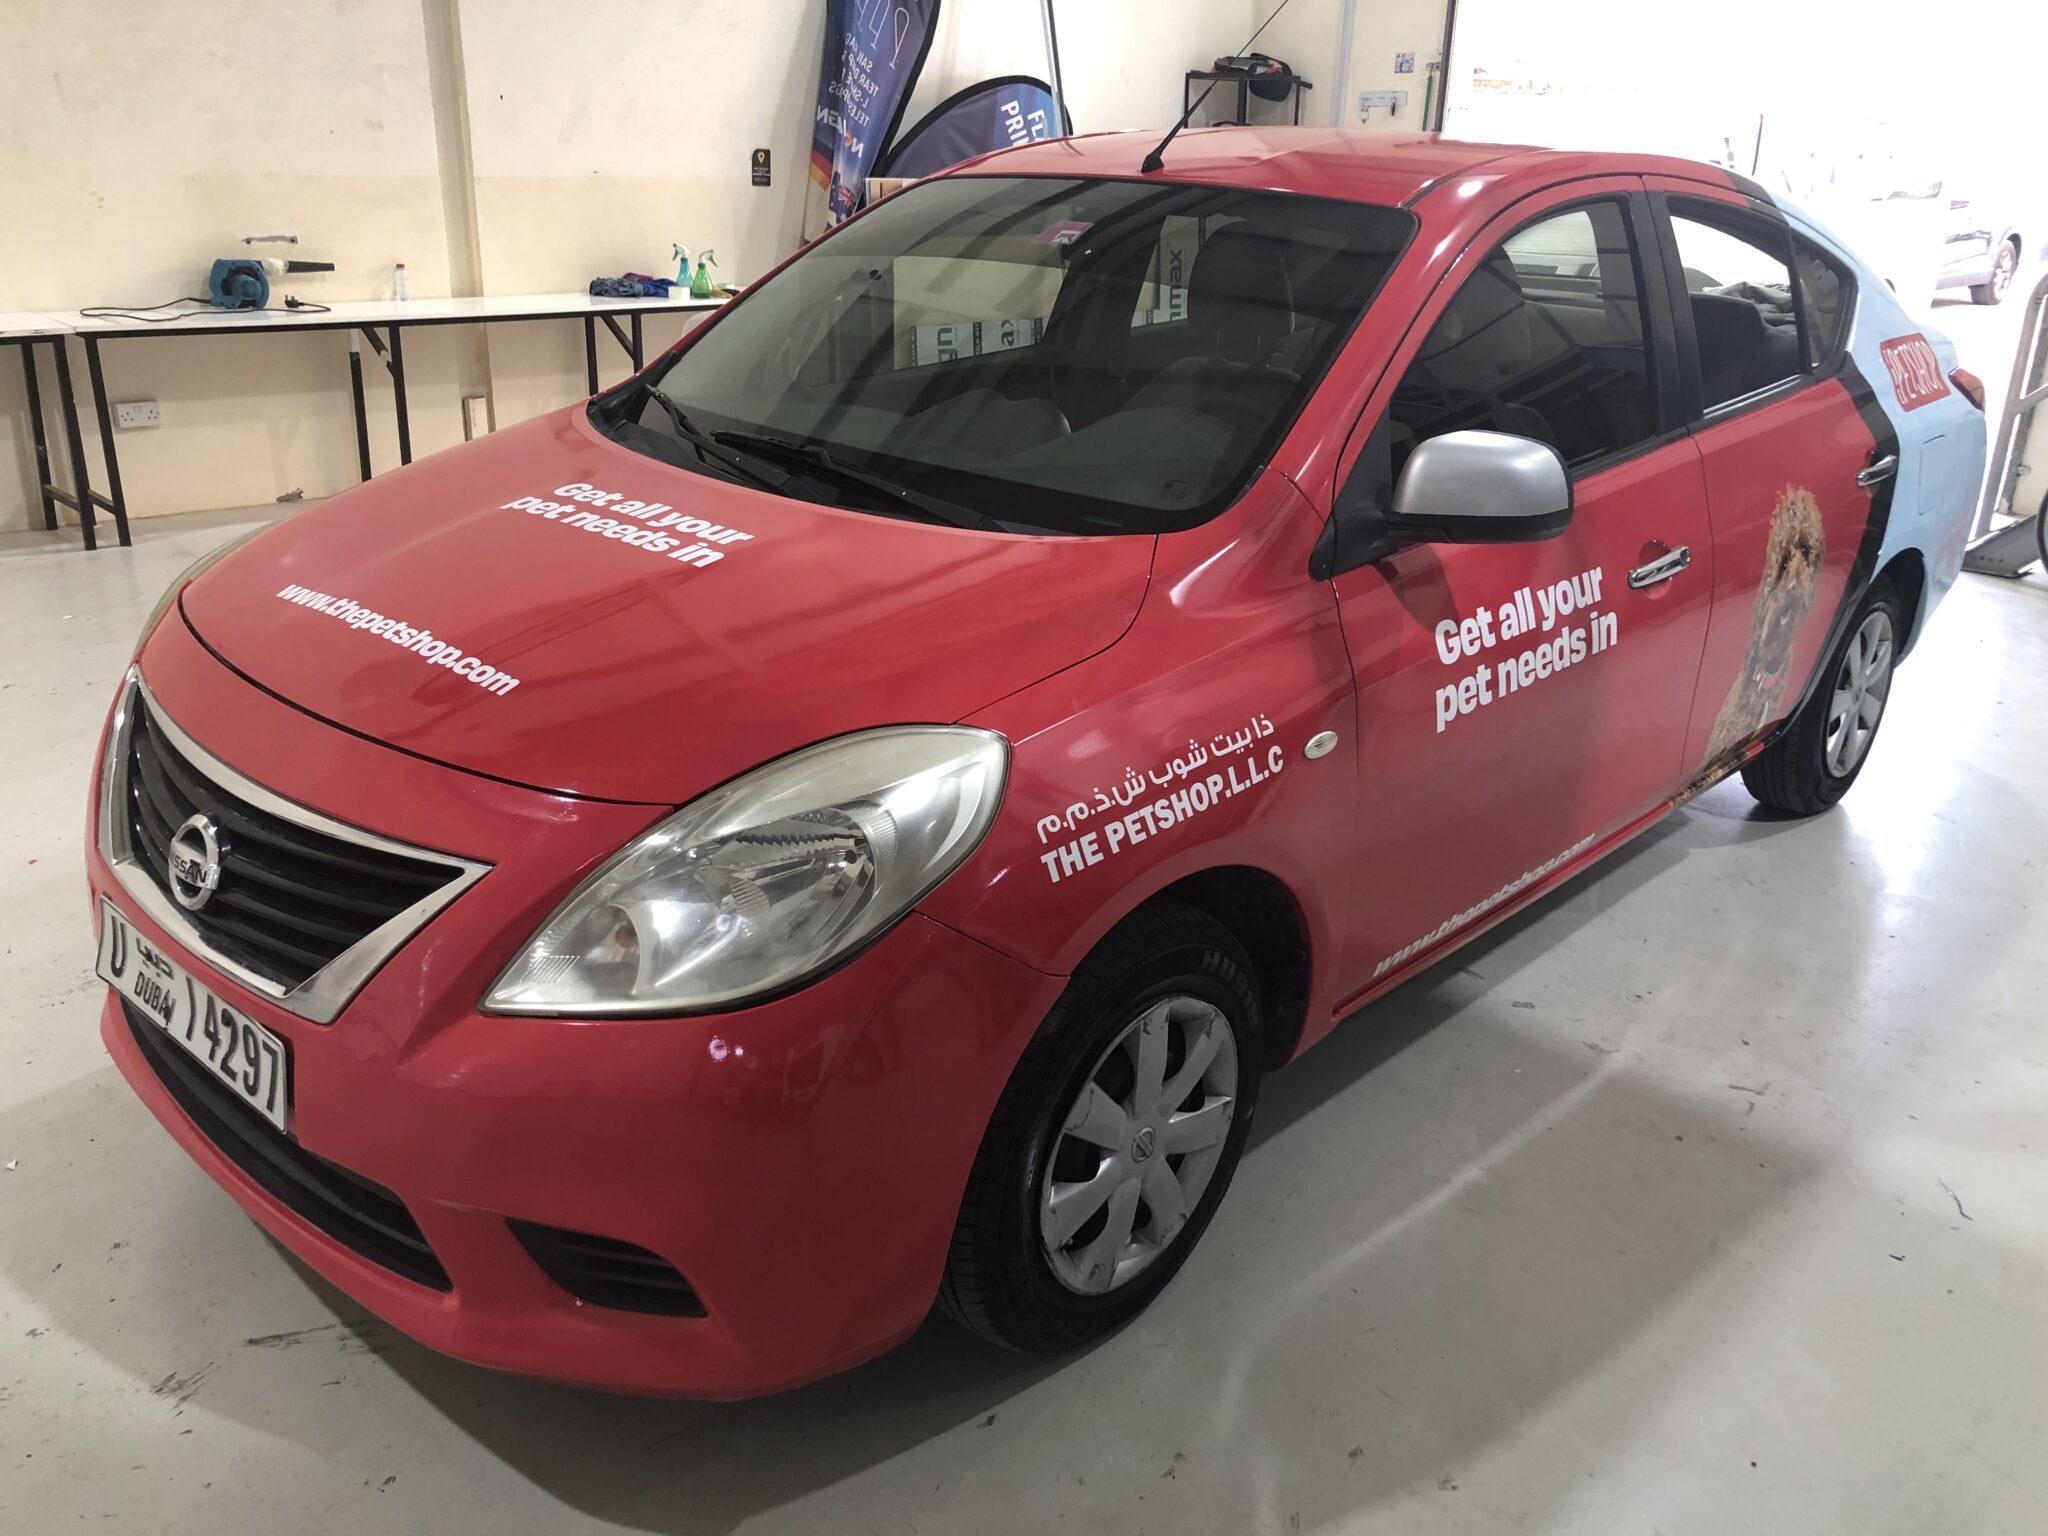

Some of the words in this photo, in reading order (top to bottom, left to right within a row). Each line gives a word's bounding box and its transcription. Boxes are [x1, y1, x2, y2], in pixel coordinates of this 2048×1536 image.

[1027, 109, 1047, 142] FL
[498, 496, 577, 519] pet
[560, 511, 681, 552] needs
[666, 542, 725, 568] in
[553, 483, 624, 507] Get
[609, 500, 673, 519] all
[645, 512, 755, 545] your
[276, 584, 521, 696] www.thepetshop.com
[1434, 606, 1497, 665] Get
[1499, 586, 1537, 641] all
[1536, 566, 1603, 632] your
[1435, 664, 1493, 734] pet
[1498, 625, 1587, 698] needs
[1590, 610, 1618, 655] in
[1209, 727, 1254, 755] بيت
[1250, 713, 1275, 740] ذا
[1148, 739, 1208, 788] شوب
[1040, 831, 1105, 884] THE
[1104, 745, 1284, 854] PETSHOP.L.L.C
[110, 915, 126, 978] U
[134, 970, 177, 1025] DUBAI
[185, 974, 279, 1114] 14297
